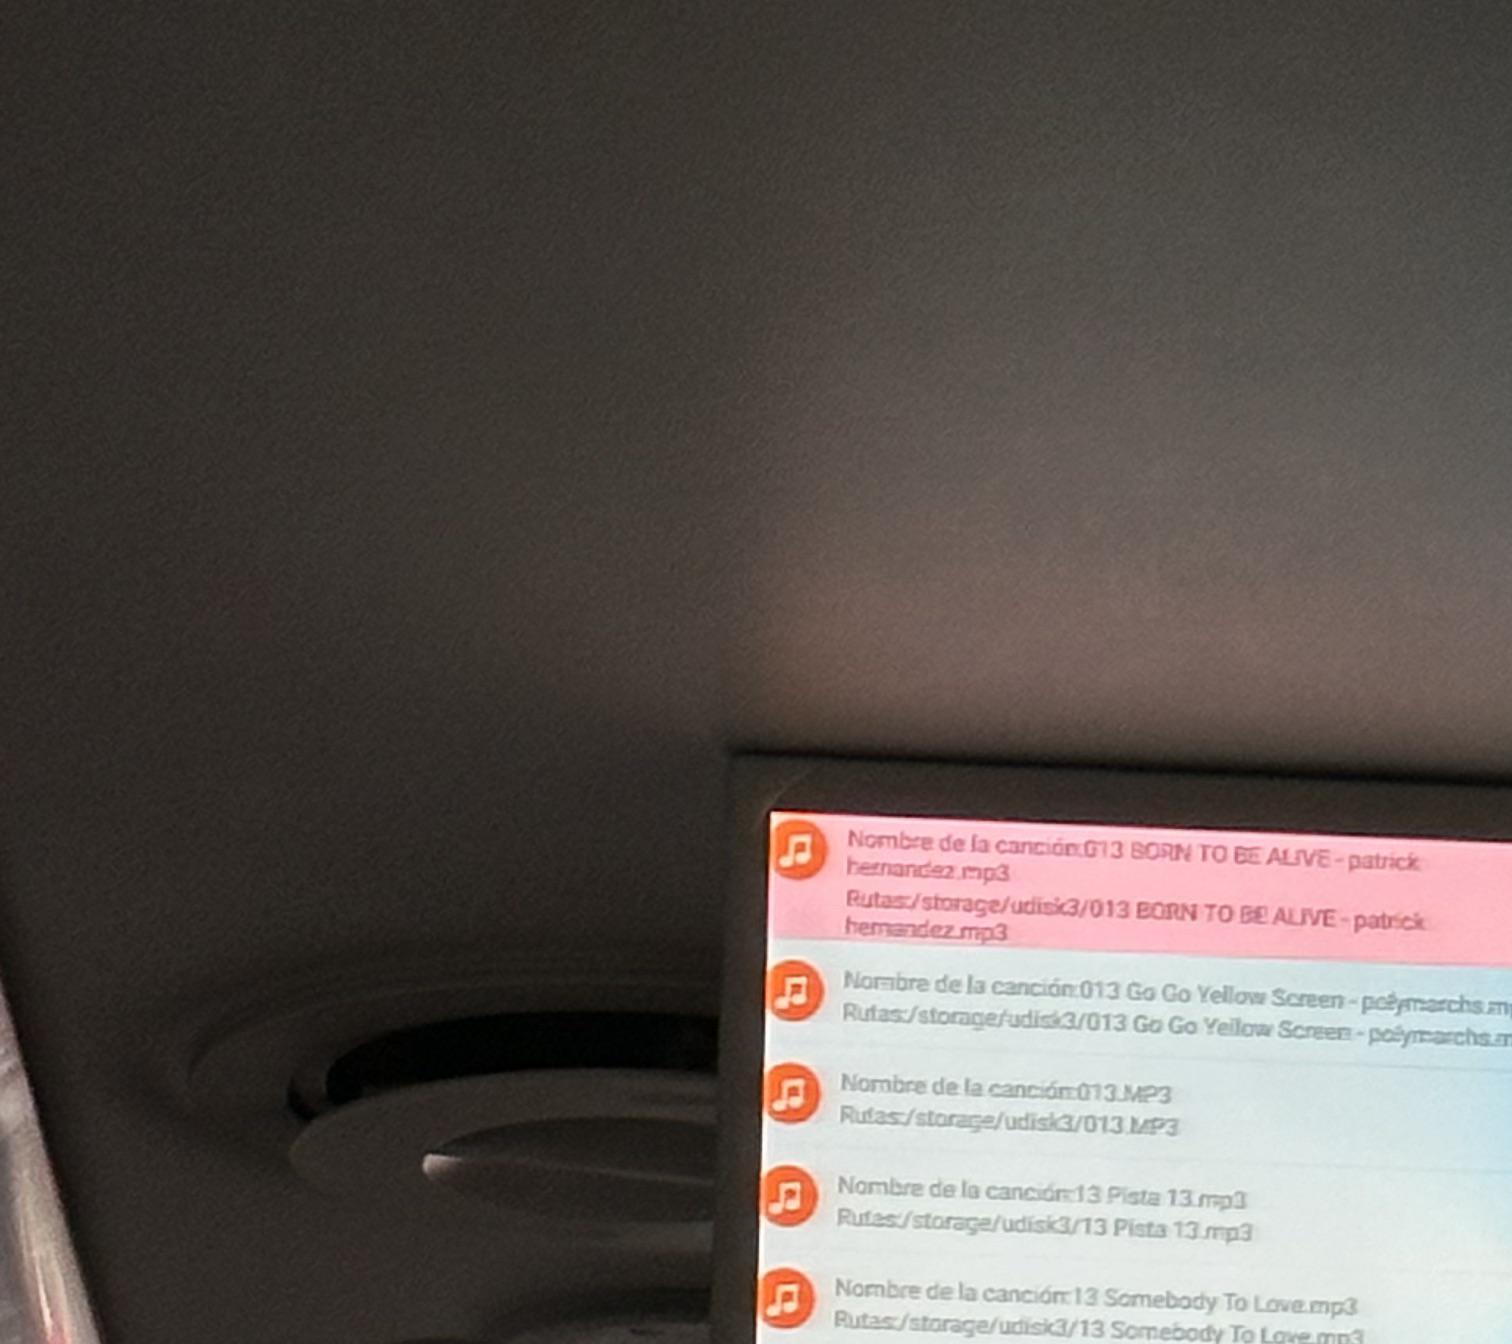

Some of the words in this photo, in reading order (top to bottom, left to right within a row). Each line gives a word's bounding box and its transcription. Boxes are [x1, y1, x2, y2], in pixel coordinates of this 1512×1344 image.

[848, 829, 933, 850] Nombre
[939, 834, 965, 853] de
[970, 834, 989, 854] la
[1131, 841, 1192, 862] BORN
[1200, 844, 1228, 864] TO
[1233, 846, 1260, 866] BE
[1265, 848, 1331, 869] ALIVE
[1348, 851, 1422, 873] patrick
[847, 857, 1010, 884] hernandez.mp3
[844, 915, 1008, 944] hernandez.mp3
[1136, 901, 1197, 922] BORN
[1205, 903, 1234, 924] TO
[1240, 905, 1267, 925] BE
[1272, 907, 1337, 928] ALIVE
[1353, 910, 1428, 933] patrick
[844, 970, 929, 993] Nombre
[935, 974, 961, 994] de
[967, 974, 985, 995] la
[1127, 982, 1155, 1002] Go
[1162, 984, 1191, 1004] Go
[1198, 985, 1266, 1008] Yellow
[1271, 988, 1344, 1010] Screen
[1133, 1014, 1162, 1034] Go
[1168, 1015, 1198, 1035] Go
[1203, 1017, 1273, 1039] Yellow
[1278, 1020, 1351, 1042] Screen
[841, 1073, 926, 1095] Nombre
[932, 1076, 958, 1096] de
[964, 1077, 983, 1097] la
[837, 1176, 923, 1198] Nombre
[930, 1180, 956, 1199] de
[961, 1180, 980, 1200] la
[1107, 1186, 1160, 1207] Pista
[1168, 1189, 1248, 1211] 13.mp3
[1114, 1218, 1167, 1238] Pista
[1174, 1221, 1253, 1245] 13.mp3
[835, 1278, 921, 1300] Nombre
[926, 1281, 953, 1301] de
[959, 1281, 978, 1303] la
[1105, 1288, 1218, 1315] Somebody
[1224, 1293, 1248, 1311] To
[1254, 1295, 1358, 1319] Love.mp3
[1230, 1325, 1255, 1344] To
